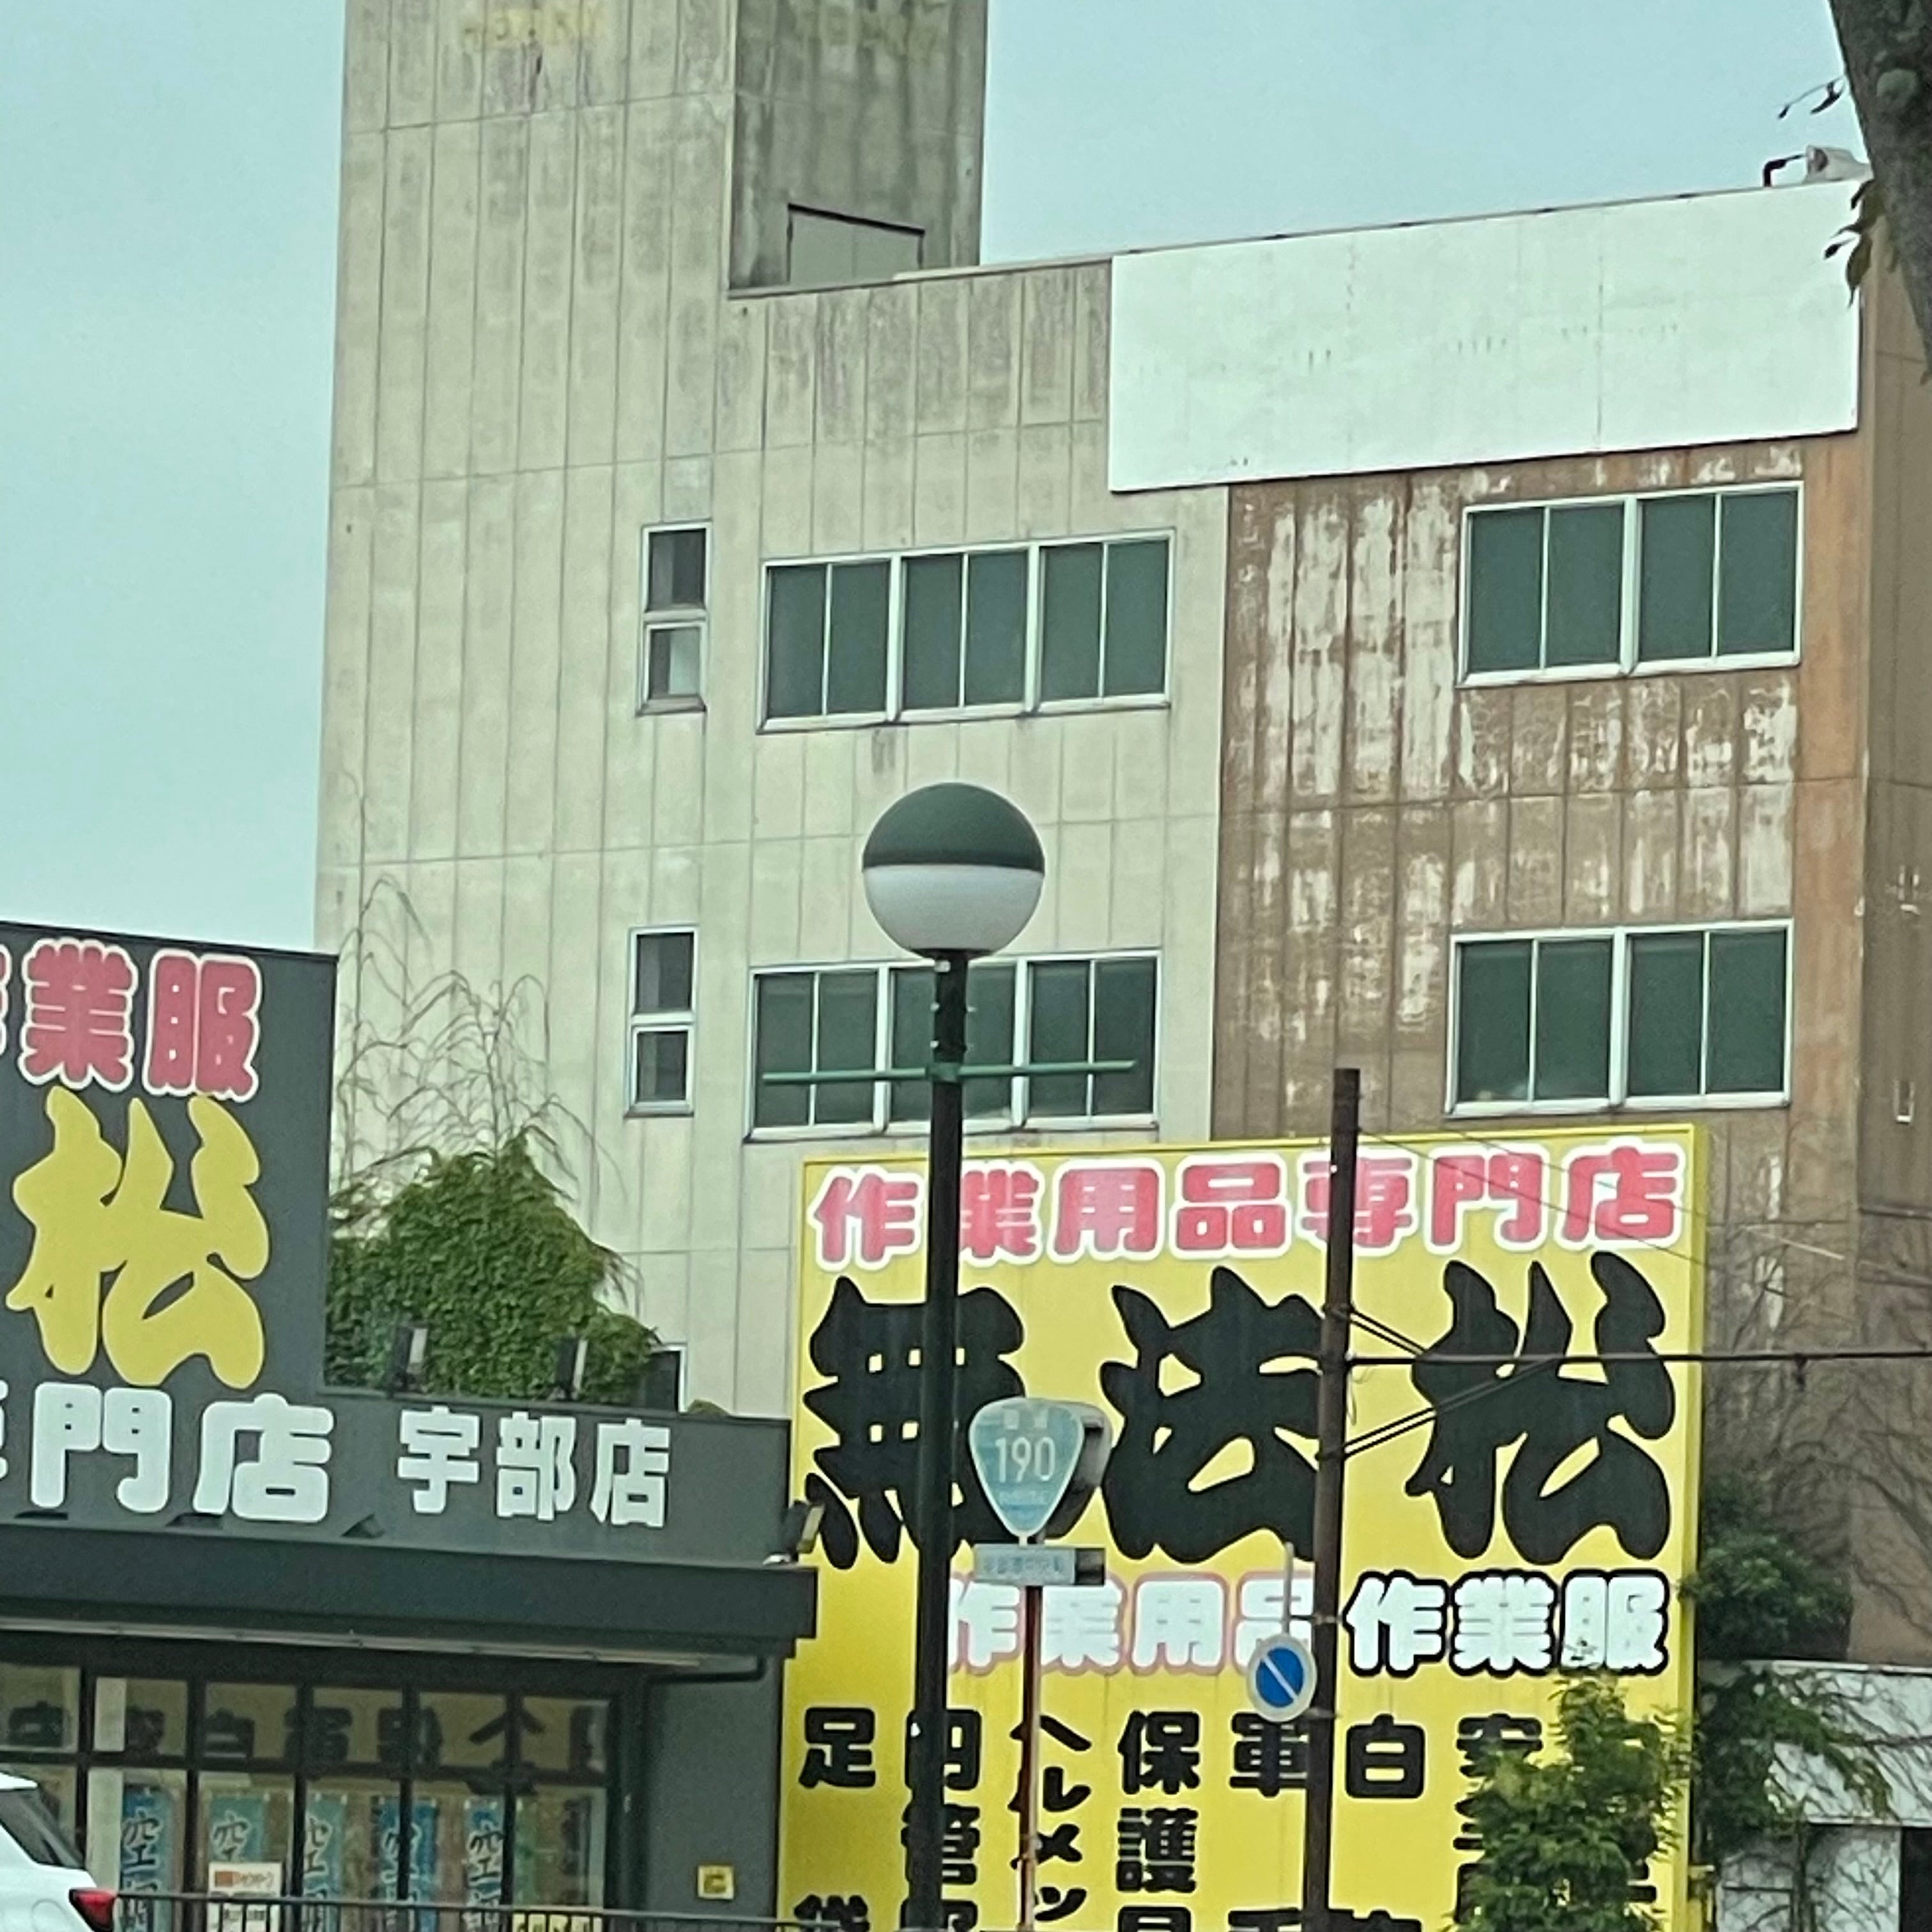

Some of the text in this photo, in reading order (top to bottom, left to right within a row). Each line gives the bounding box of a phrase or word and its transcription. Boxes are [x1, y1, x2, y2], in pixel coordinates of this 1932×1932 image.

[0, 937, 263, 1101] 業服
[808, 1136, 1687, 1270] 作業用品専門店
[0, 1380, 671, 1528] 門店 宇部店
[995, 1437, 1056, 1484] 190
[1343, 1567, 1669, 1679] 作業服
